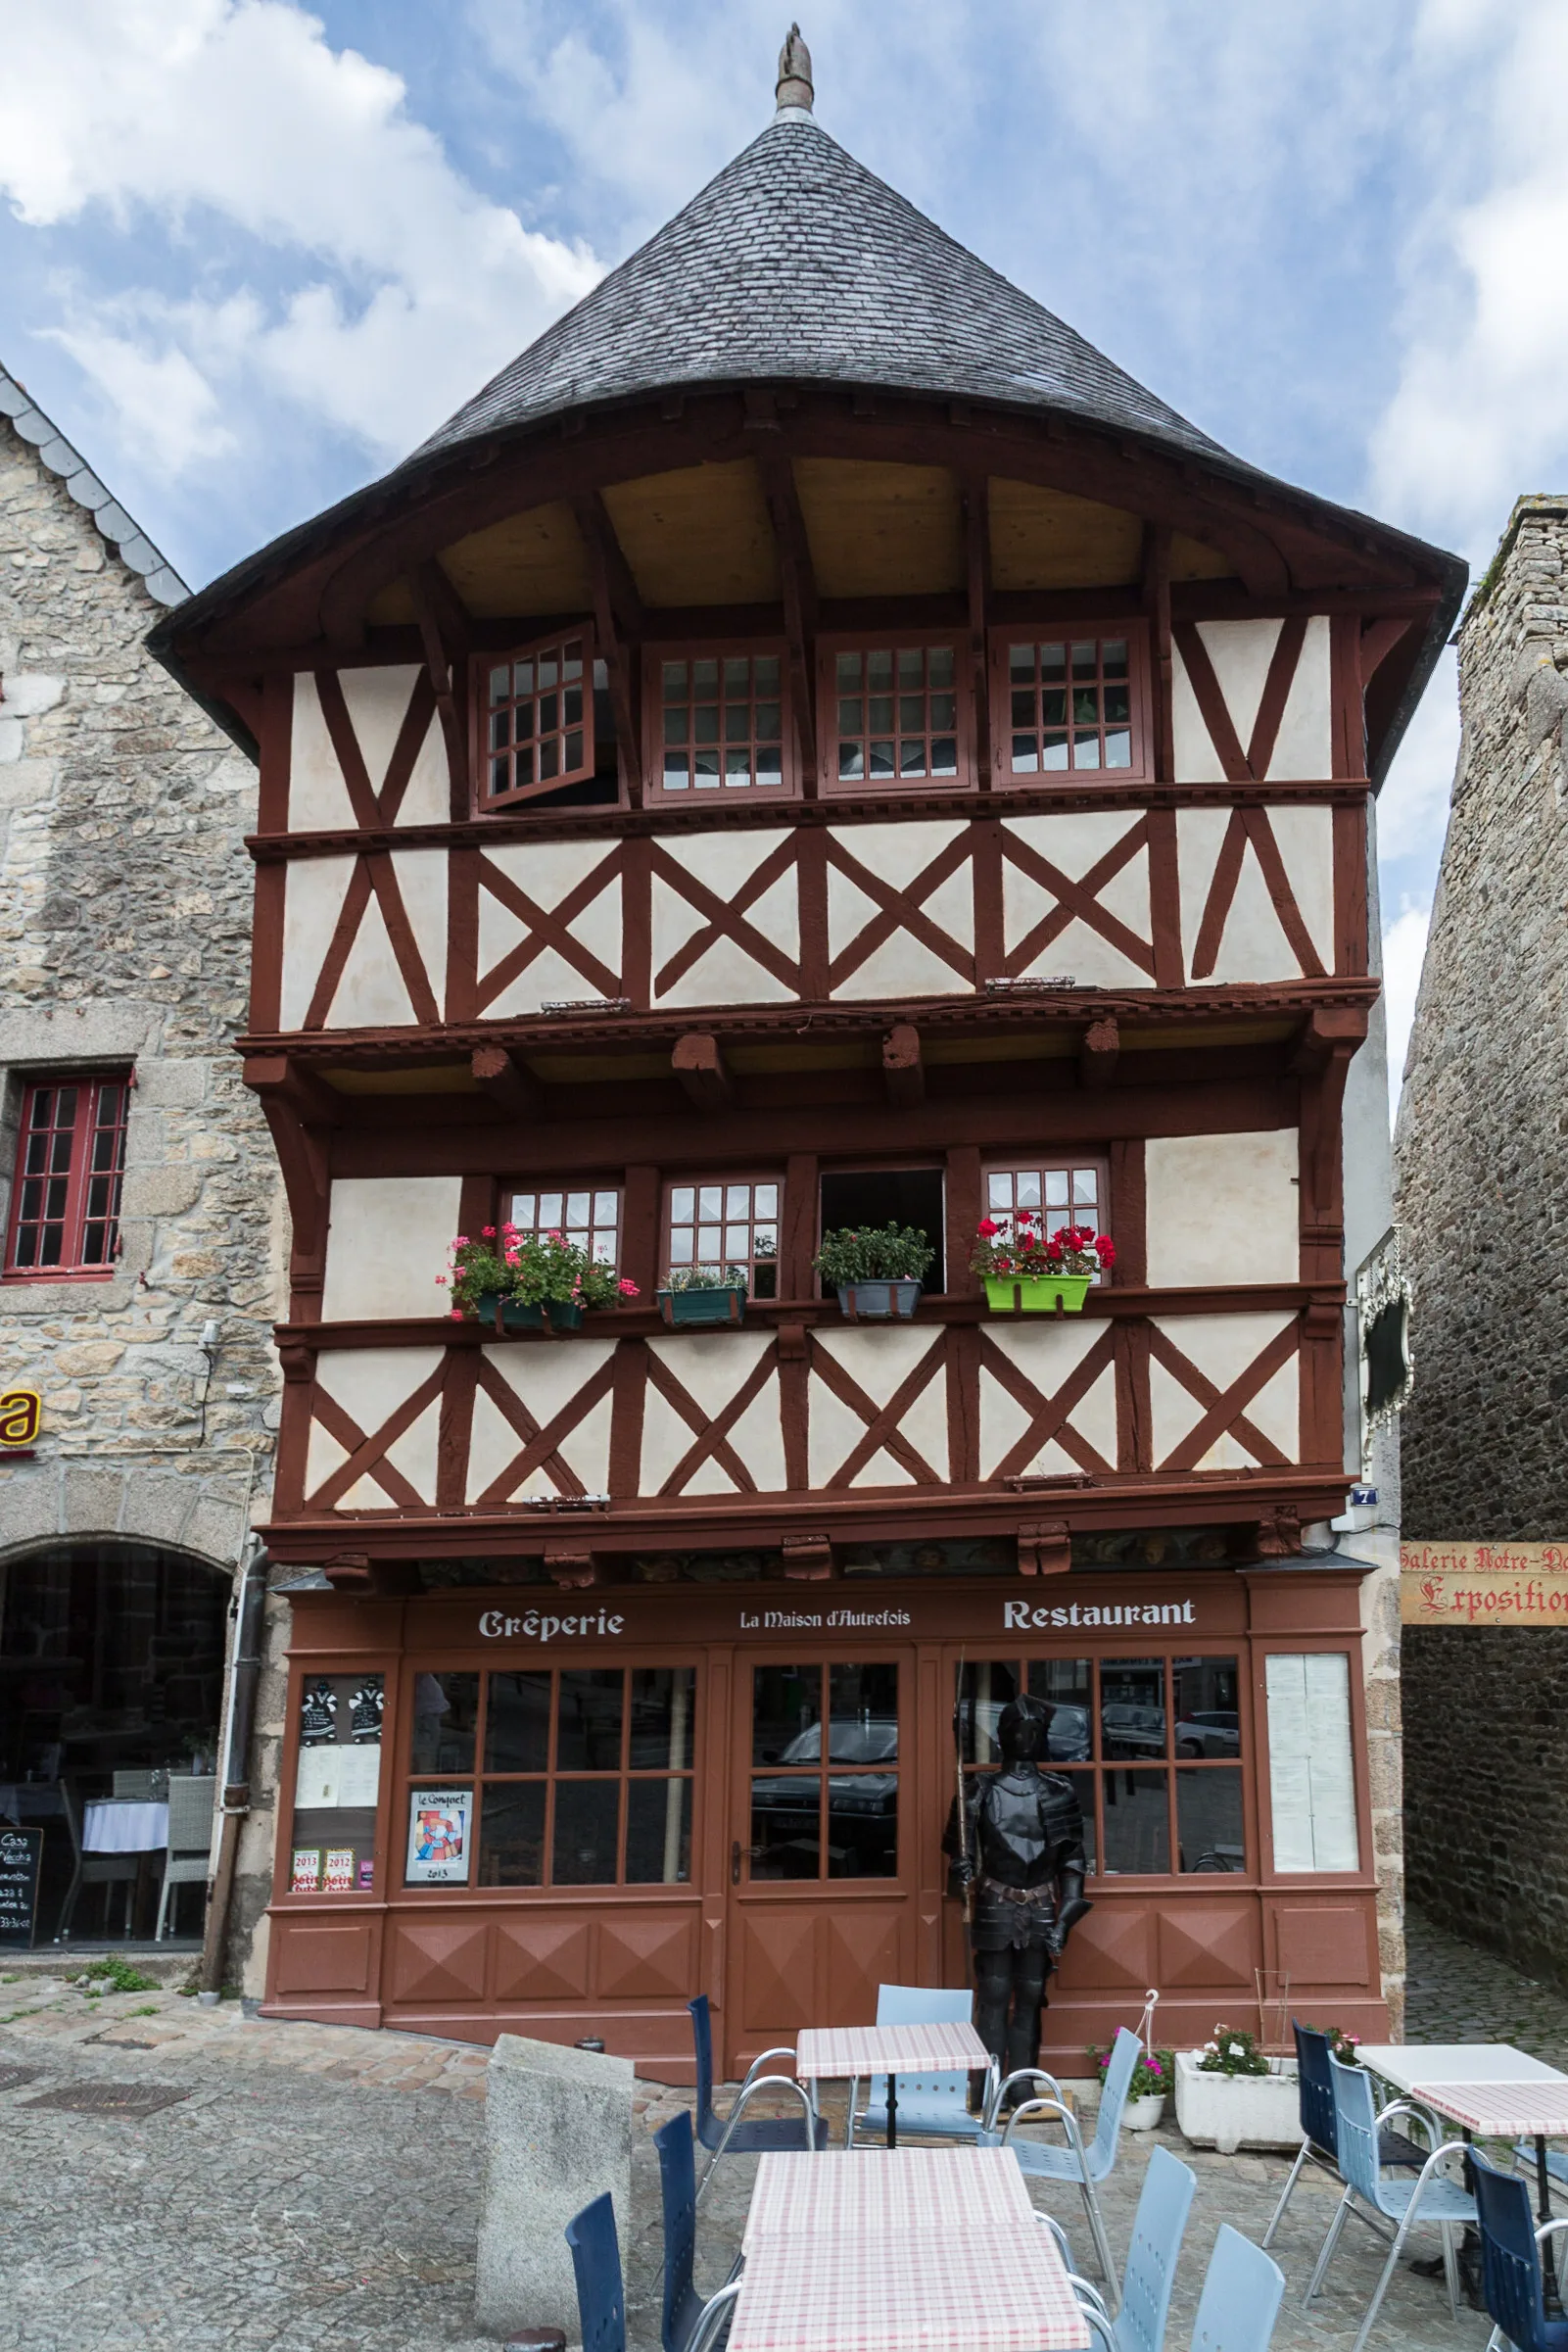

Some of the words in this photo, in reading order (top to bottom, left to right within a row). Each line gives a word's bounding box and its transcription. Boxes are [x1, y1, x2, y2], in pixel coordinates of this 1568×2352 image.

[1358, 1490, 1370, 1504] 7
[739, 1611, 760, 1628] La
[764, 1610, 823, 1628] Maison
[826, 1608, 912, 1627] d'Autrefois
[1003, 1599, 1197, 1629] Restaurant
[478, 1608, 626, 1642] Crêperie
[295, 1856, 317, 1867] 2013
[328, 1857, 351, 1867] 2012
[426, 1869, 449, 1879] 2013
